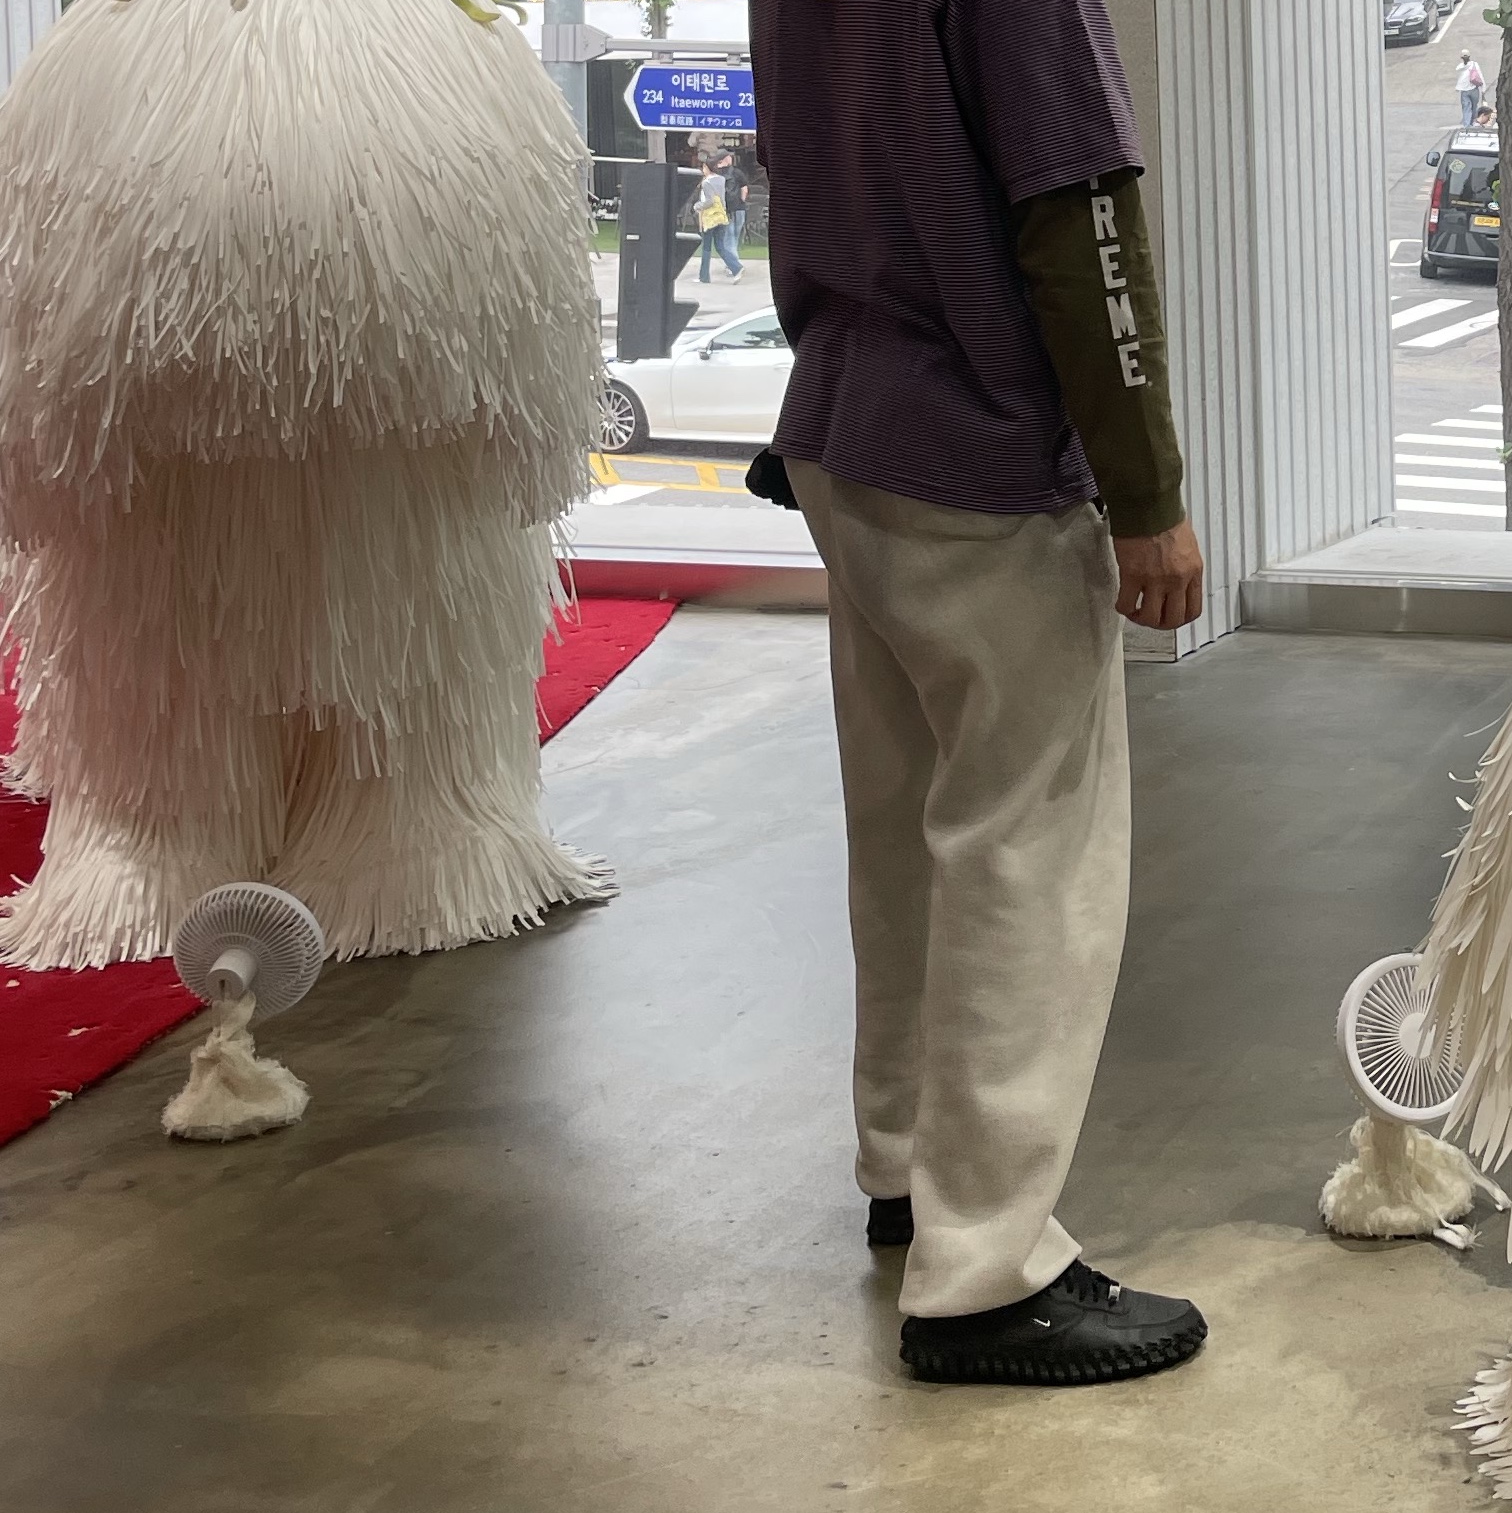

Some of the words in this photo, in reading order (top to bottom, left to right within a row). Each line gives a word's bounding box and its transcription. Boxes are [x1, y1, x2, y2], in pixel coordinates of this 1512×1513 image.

[671, 72, 730, 93] 이태원로
[642, 89, 664, 104] 234
[671, 95, 731, 110] Itaewon-ro
